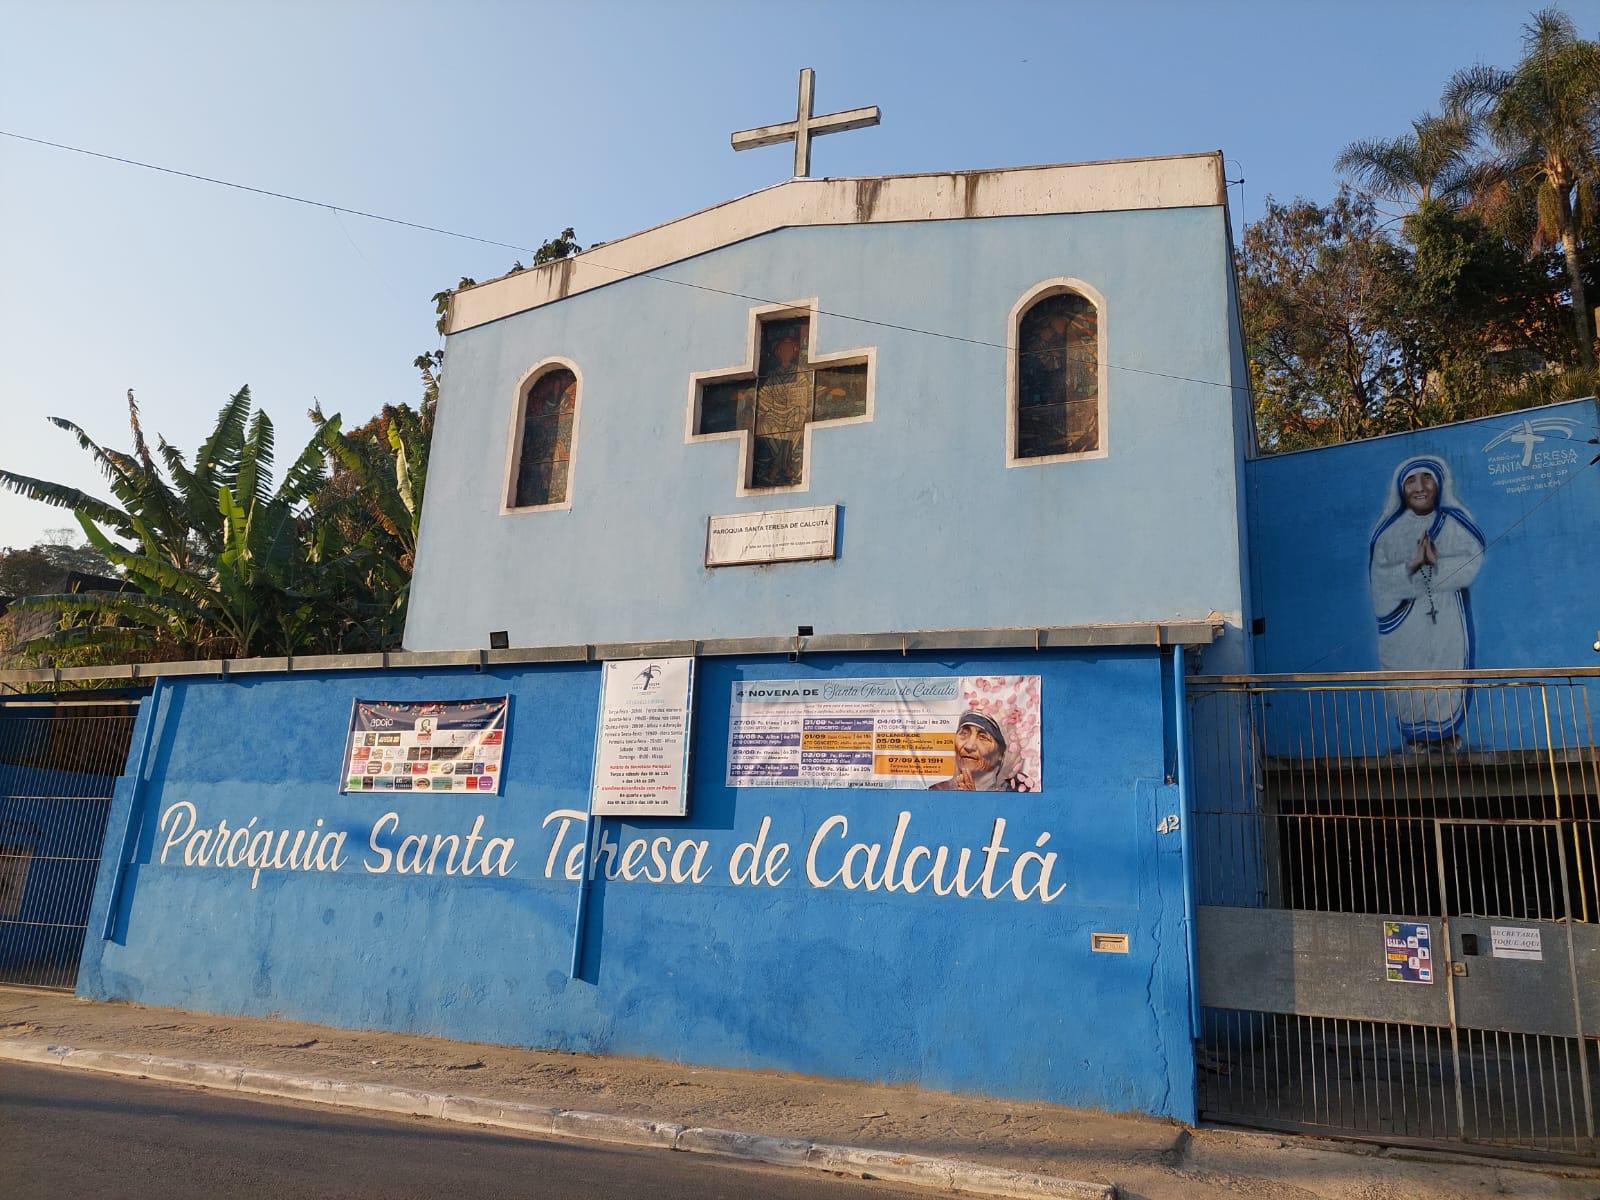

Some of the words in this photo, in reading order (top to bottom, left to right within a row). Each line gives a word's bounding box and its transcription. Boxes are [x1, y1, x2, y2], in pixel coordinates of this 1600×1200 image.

[1487, 460, 1522, 475] SANTA
[748, 689, 800, 698] NOVENA
[802, 688, 819, 697] DE
[824, 682, 858, 700] Santa
[861, 682, 896, 698] Teresa
[898, 686, 910, 696] de
[1156, 814, 1180, 835] 42
[160, 800, 349, 890] Paróquia
[363, 811, 519, 877] Santa
[542, 808, 713, 885] Teresa
[729, 815, 792, 887] de
[805, 810, 1067, 902] Calcutá
[1492, 929, 1539, 939] SECRETARIA
[1493, 939, 1519, 947] TOQUE
